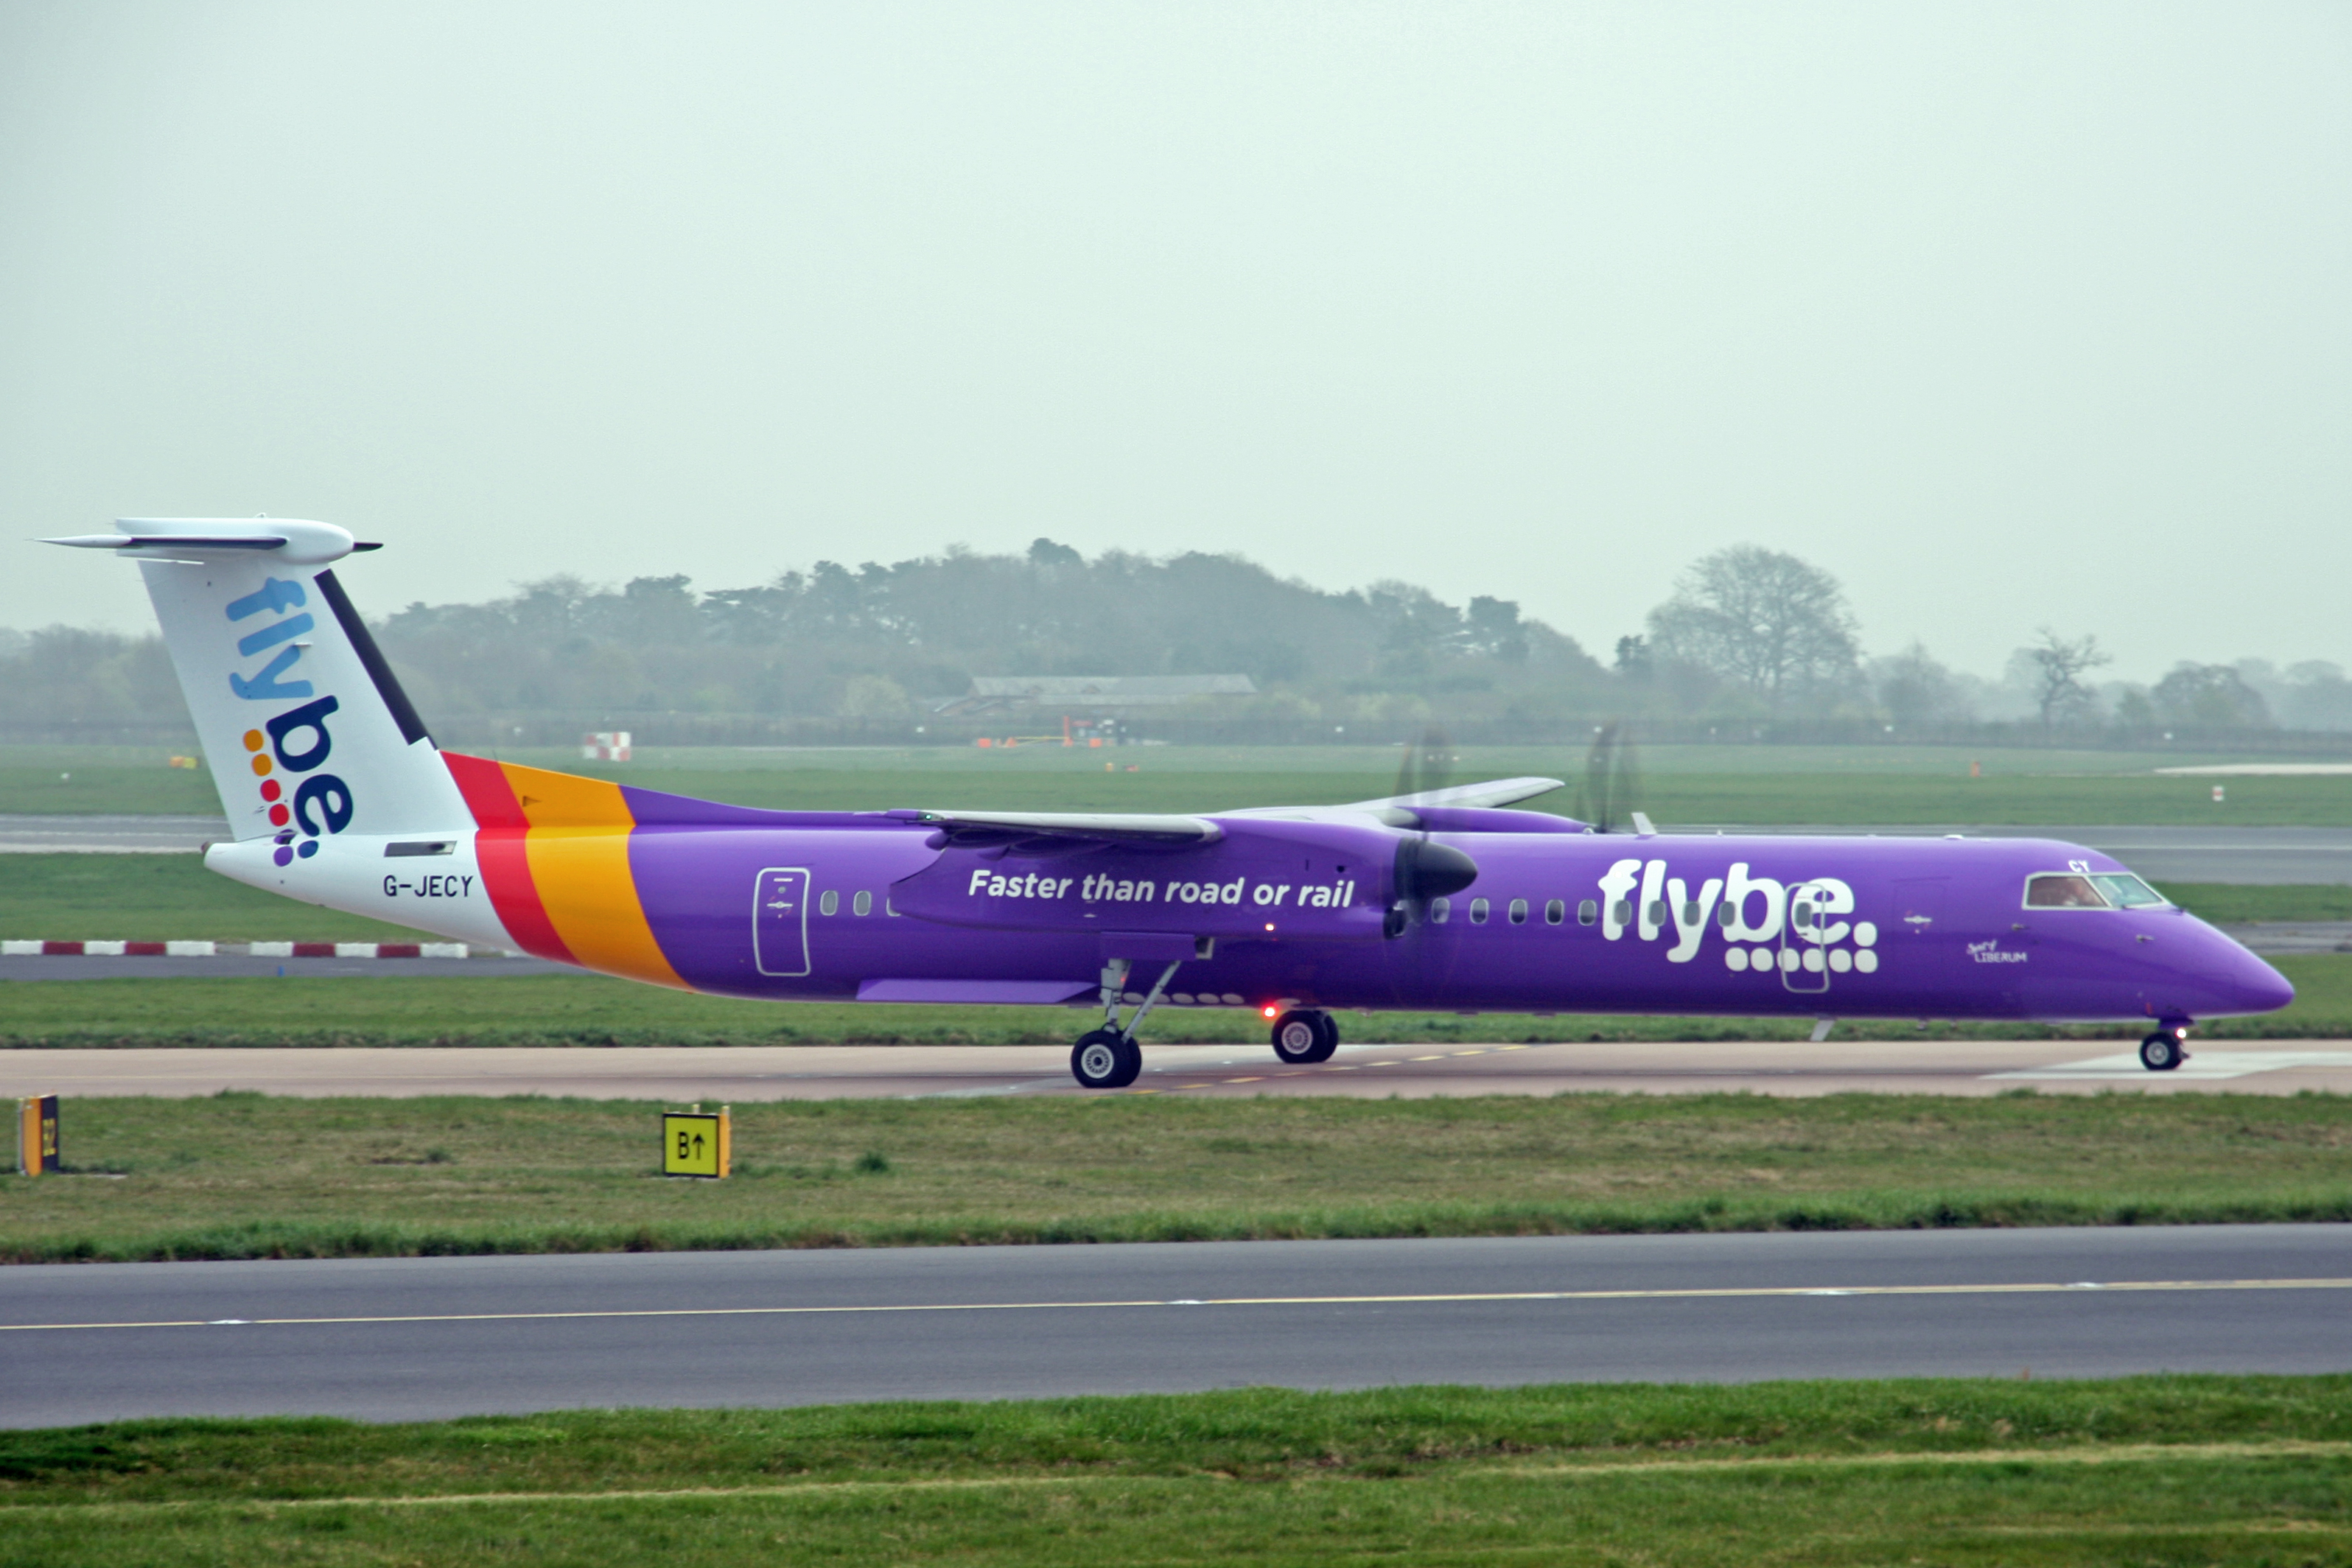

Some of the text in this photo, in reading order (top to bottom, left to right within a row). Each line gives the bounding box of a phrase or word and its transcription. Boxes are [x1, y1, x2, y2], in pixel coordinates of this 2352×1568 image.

[2068, 859, 2090, 873] CY
[383, 875, 474, 897] G-JECY
[968, 869, 1354, 908] Faster than road or rail
[678, 1132, 690, 1159] B
